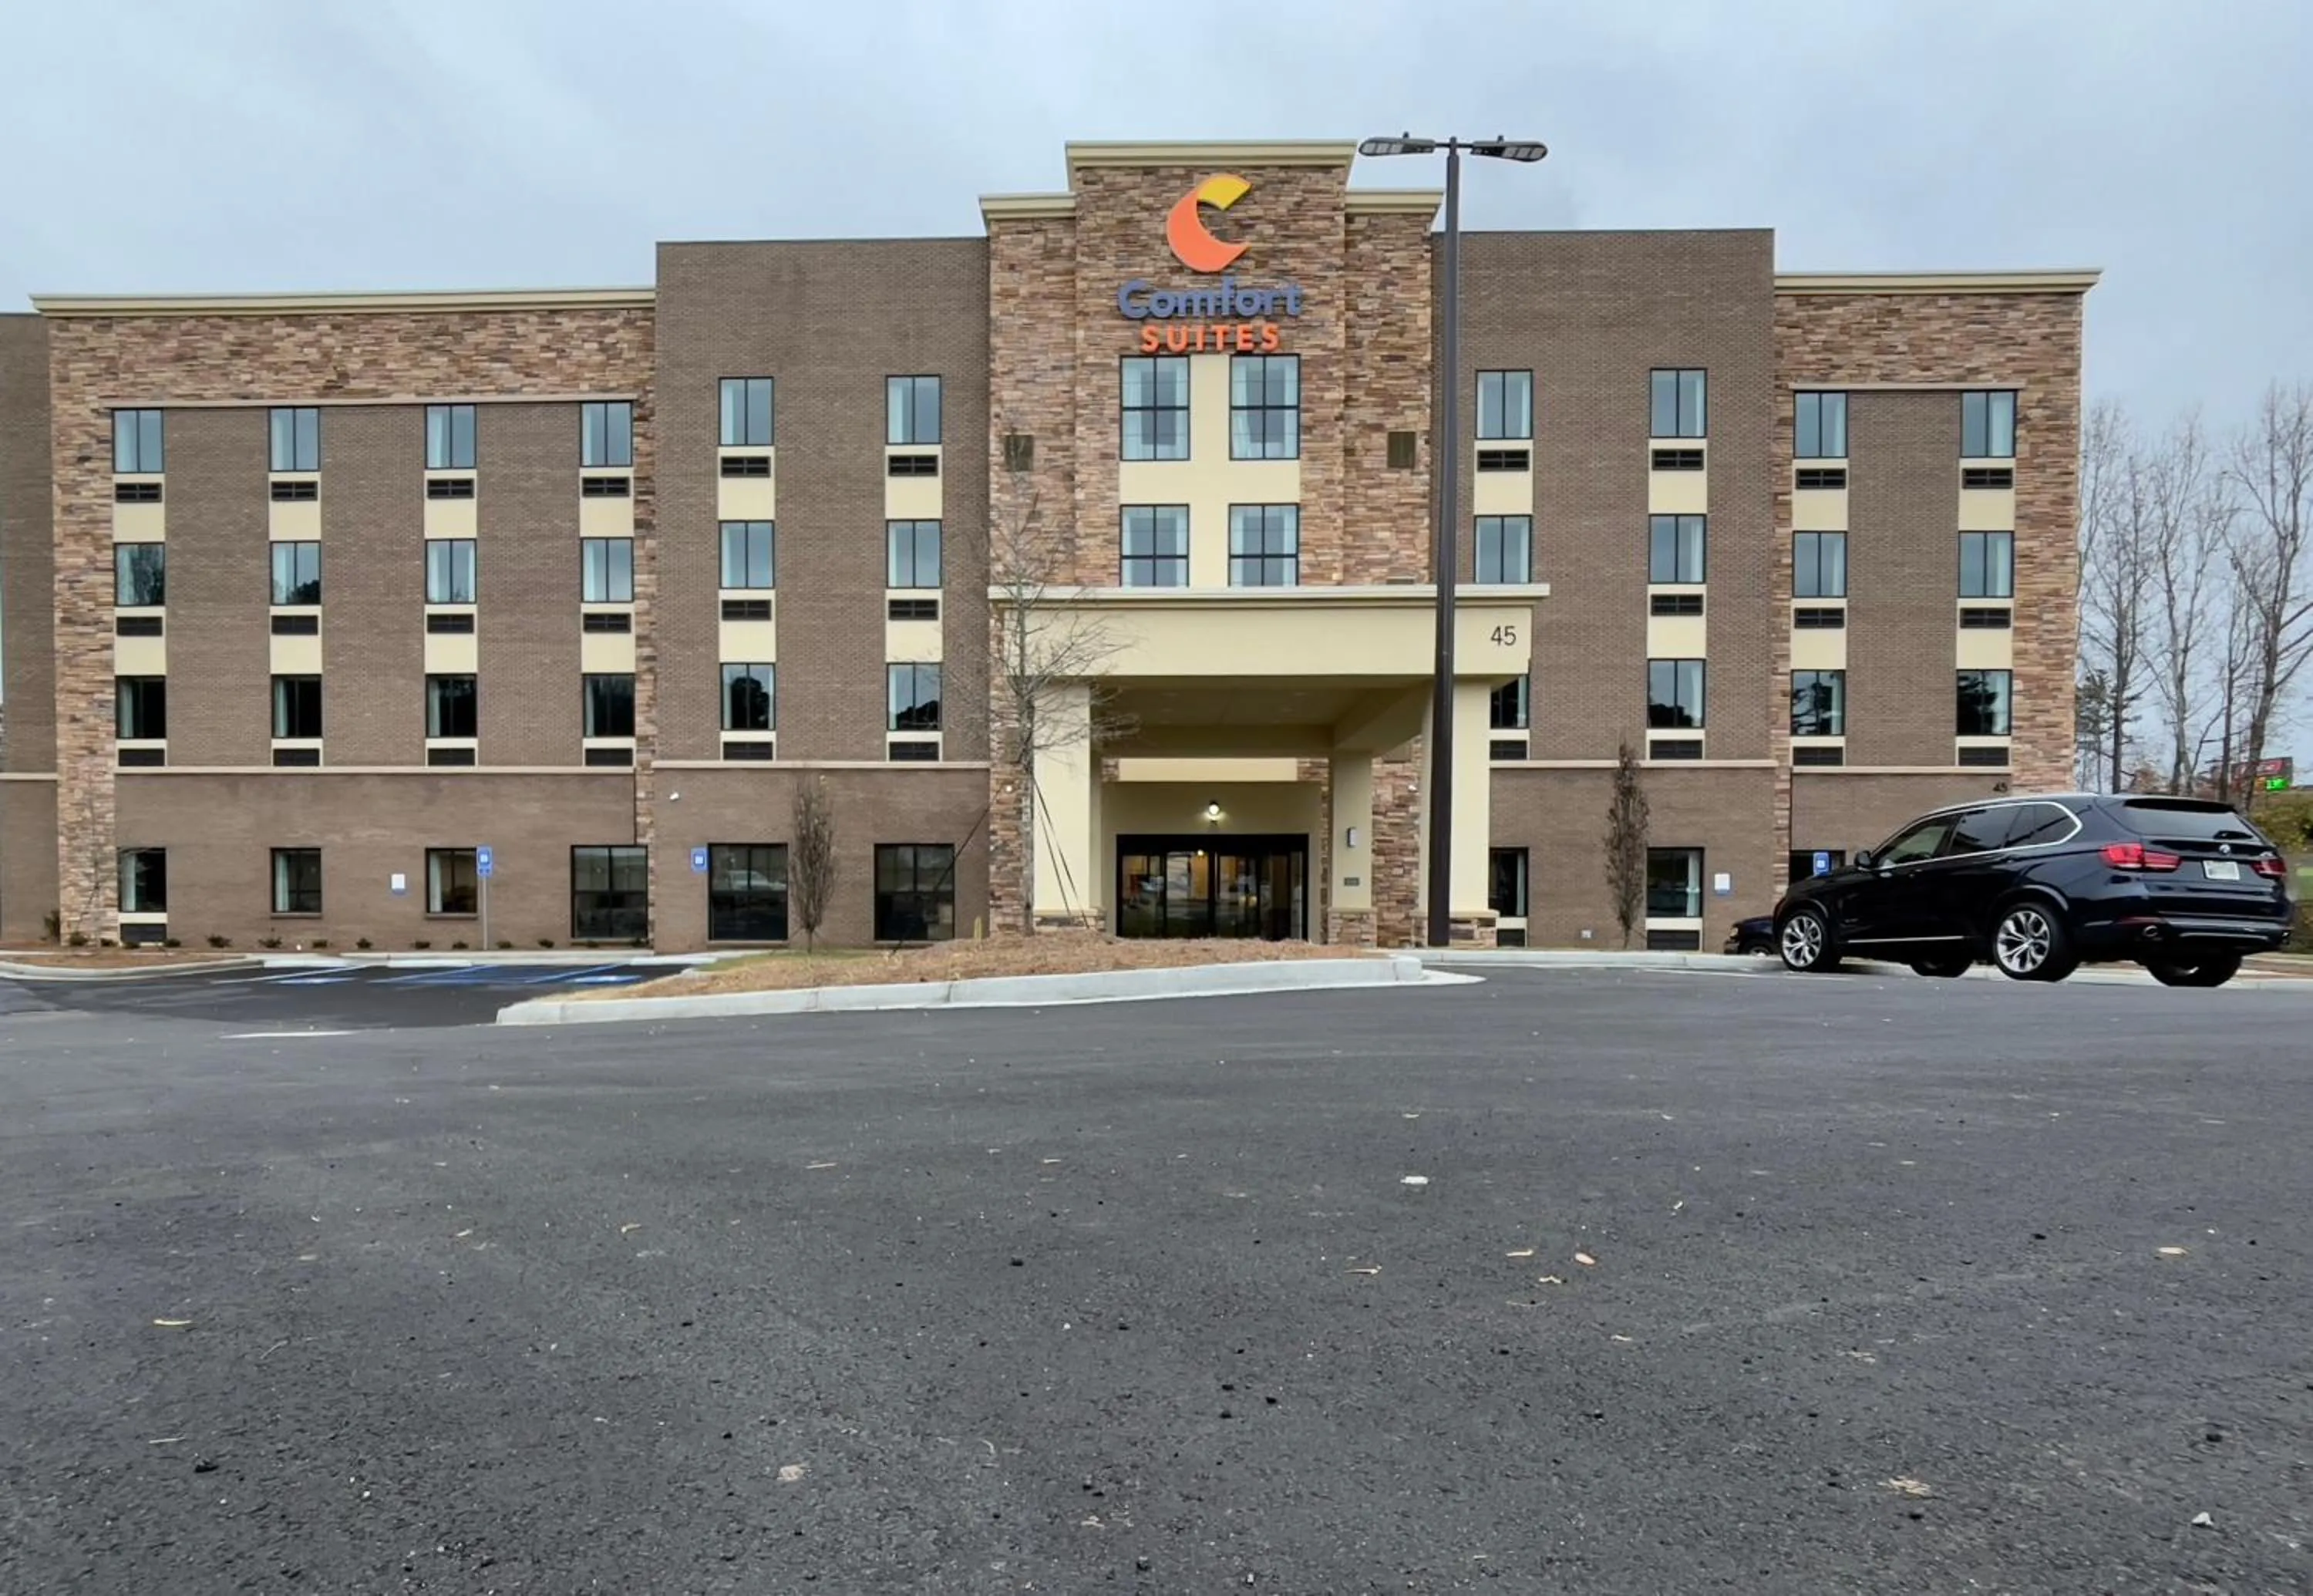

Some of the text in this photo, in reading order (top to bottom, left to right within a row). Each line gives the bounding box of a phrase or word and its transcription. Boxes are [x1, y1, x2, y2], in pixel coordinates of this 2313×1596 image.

[1118, 277, 1302, 318] Comfort
[1140, 323, 1281, 352] SUITES
[1490, 625, 1517, 646] 45
